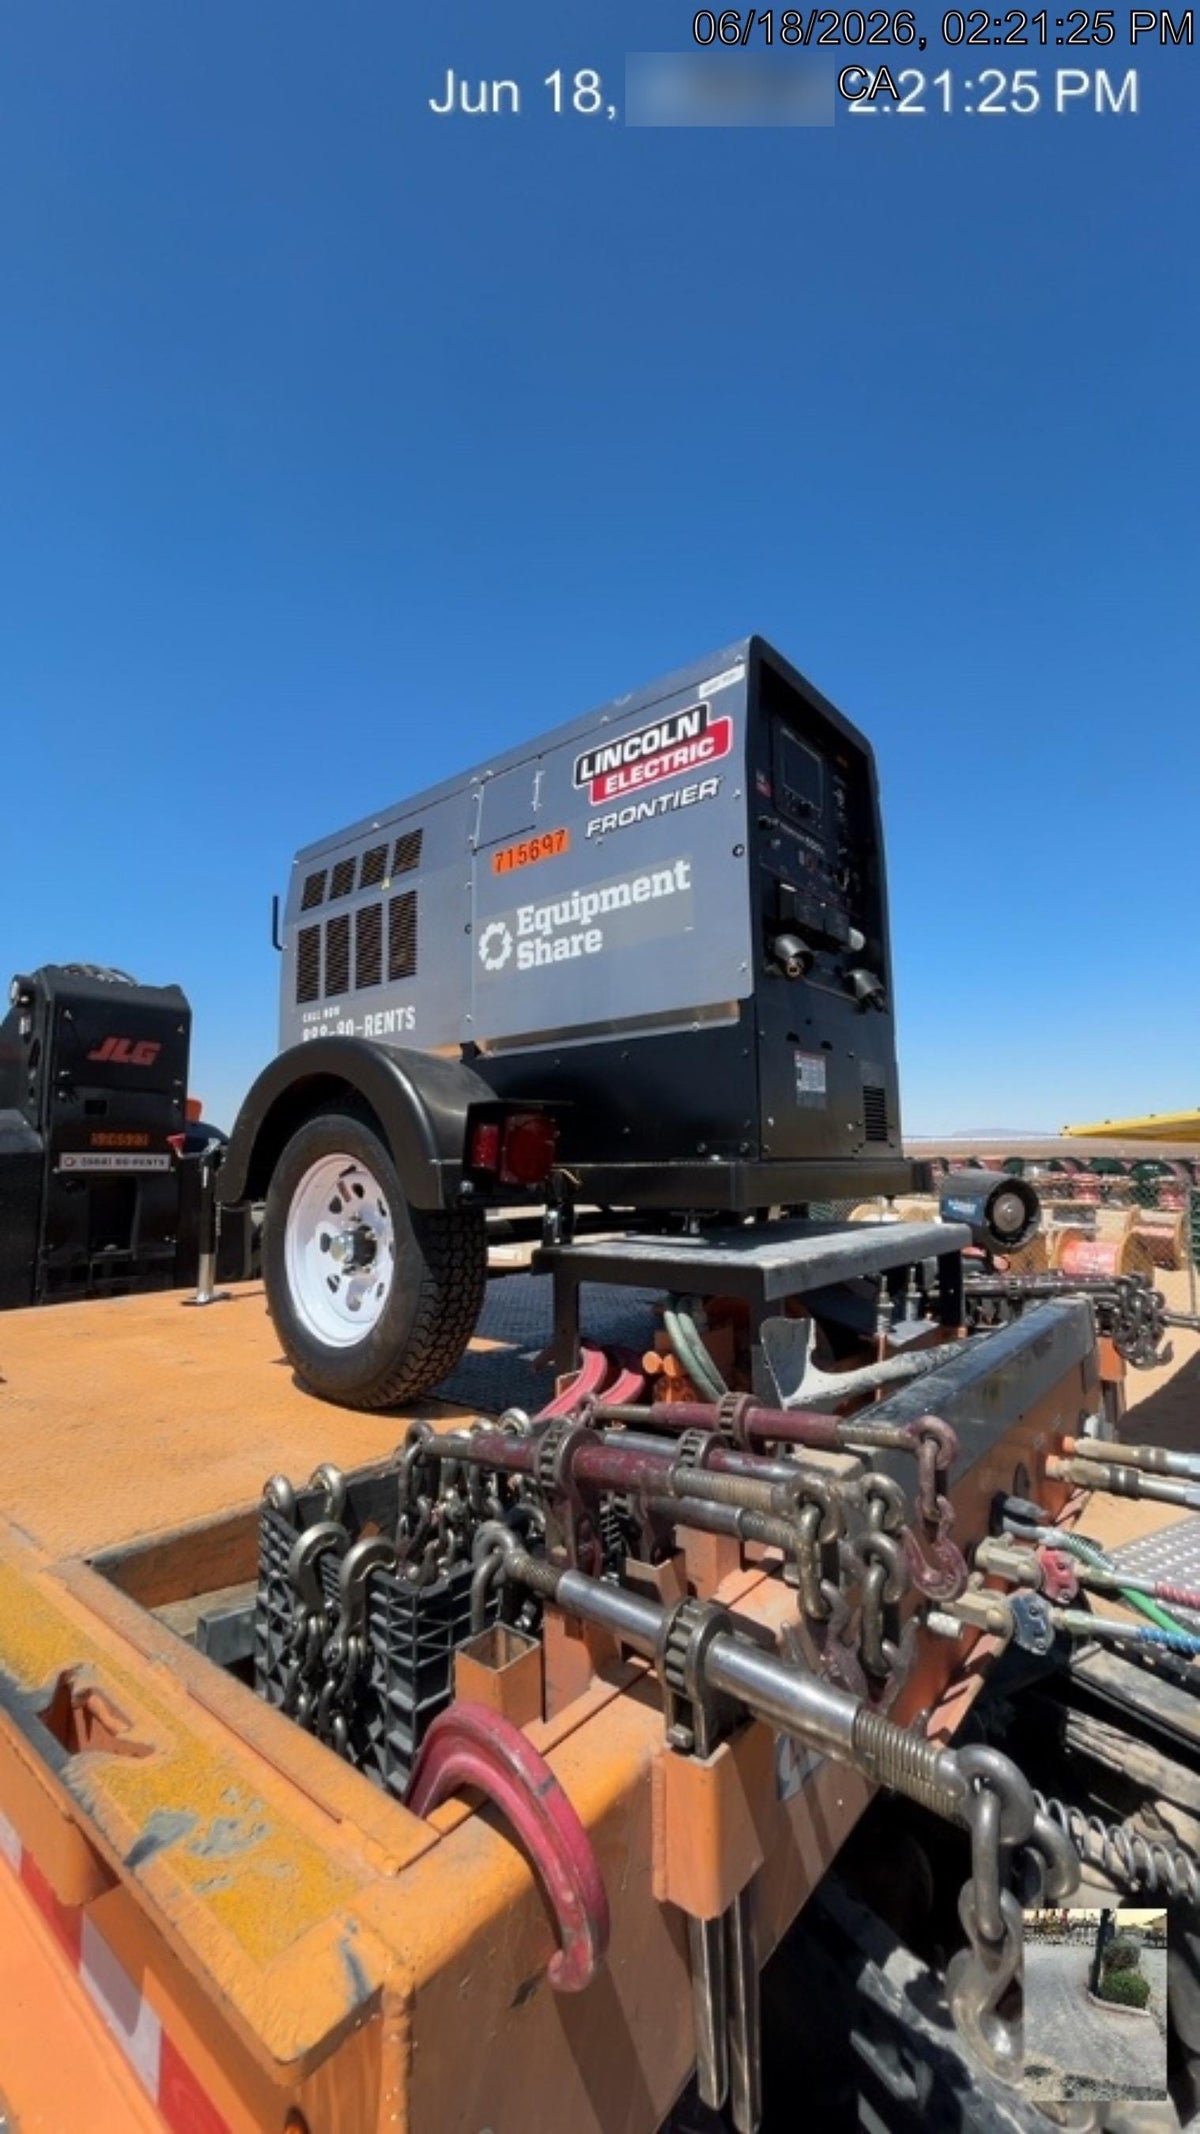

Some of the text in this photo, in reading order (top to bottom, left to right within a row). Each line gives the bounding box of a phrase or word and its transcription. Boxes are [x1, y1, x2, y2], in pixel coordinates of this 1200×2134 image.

[579, 709, 702, 781] LINCOLN
[604, 736, 717, 796] ELECTRIC
[585, 777, 720, 839] FRONTIER
[495, 829, 566, 873] 715697
[516, 859, 692, 935] Equipment
[516, 929, 603, 970] Share
[86, 1037, 163, 1066] JLG
